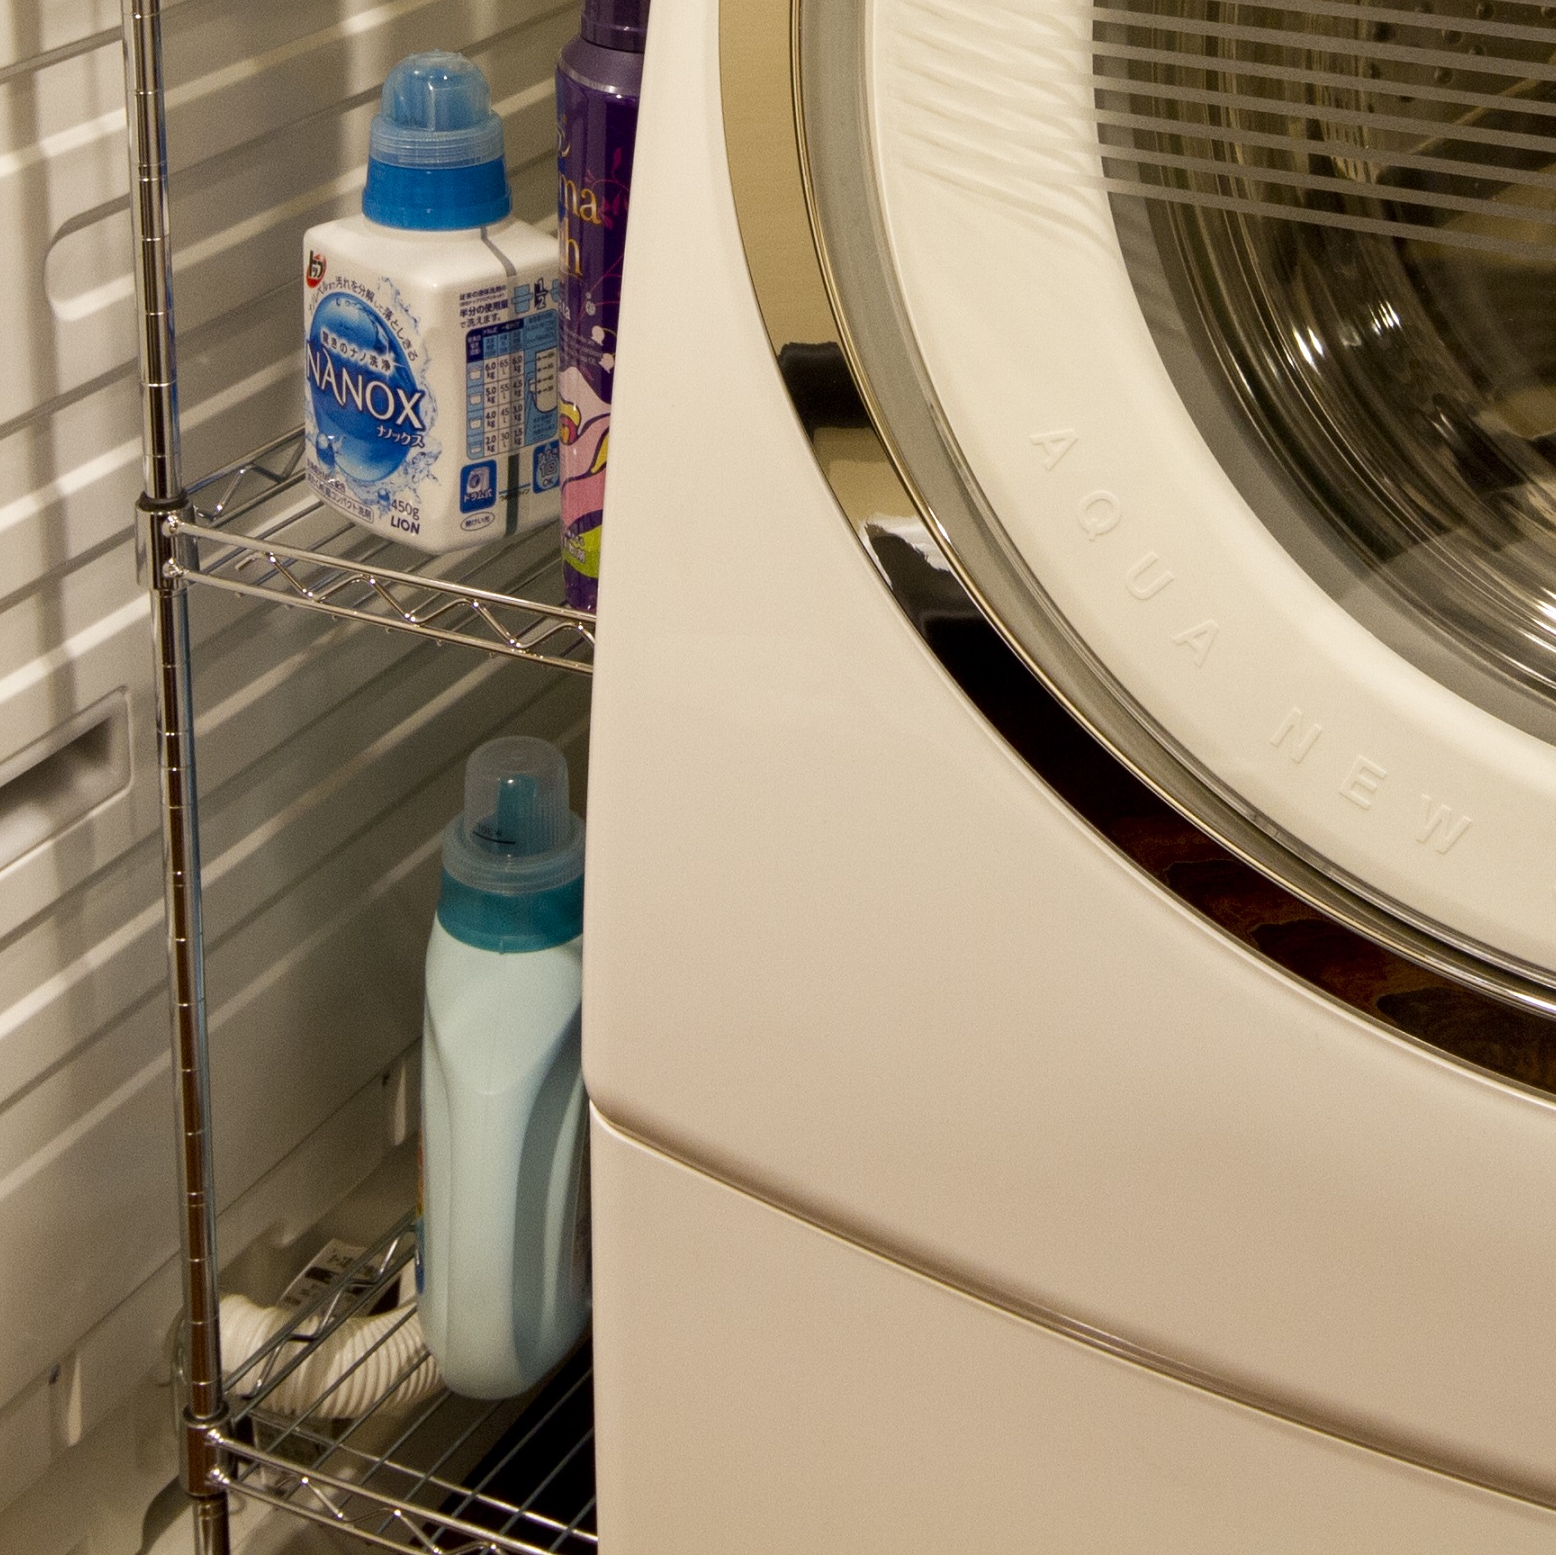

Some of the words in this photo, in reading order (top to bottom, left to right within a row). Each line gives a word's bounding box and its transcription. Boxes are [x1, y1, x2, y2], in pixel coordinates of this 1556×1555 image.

[305, 341, 424, 430] NANOX
[376, 424, 426, 448] ナノックス
[391, 499, 420, 521] 450g
[390, 515, 420, 535] LION
[1028, 427, 1220, 669] AQUA
[1268, 705, 1474, 857] NEW
